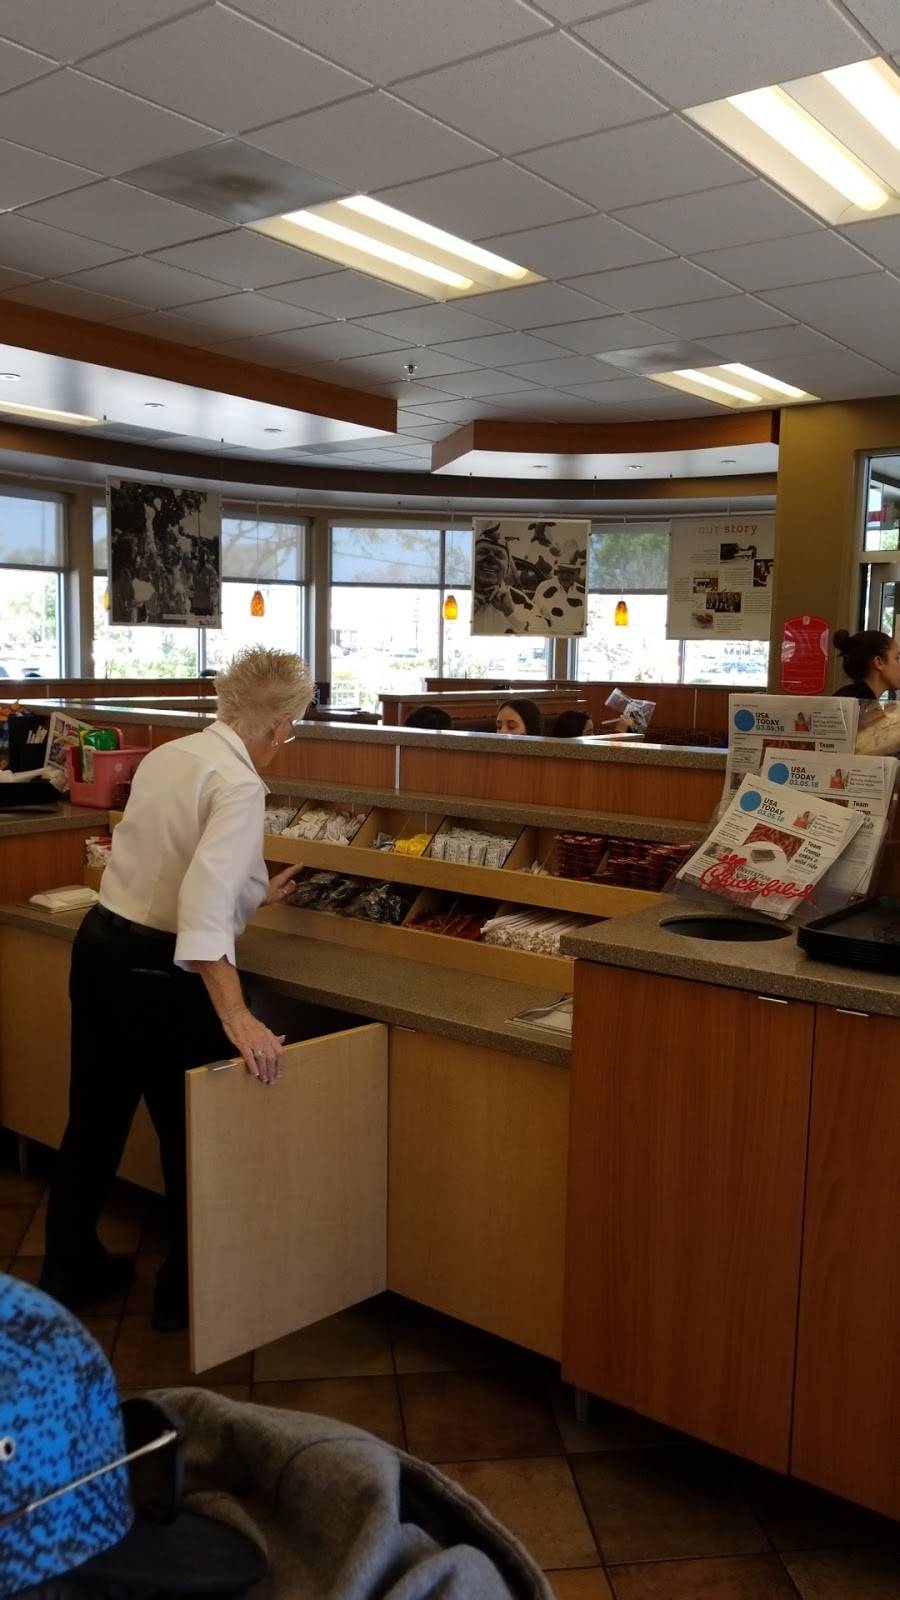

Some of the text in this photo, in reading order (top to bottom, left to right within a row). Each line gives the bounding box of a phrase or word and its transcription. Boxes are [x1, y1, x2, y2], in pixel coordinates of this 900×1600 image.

[698, 524, 758, 536] our story
[755, 711, 770, 719] USA
[756, 718, 780, 726] TODAY
[790, 772, 816, 781] TODAY
[763, 797, 778, 807] USA
[852, 800, 869, 808] Team
[761, 803, 785, 815] TODAY
[807, 840, 822, 850] Team
